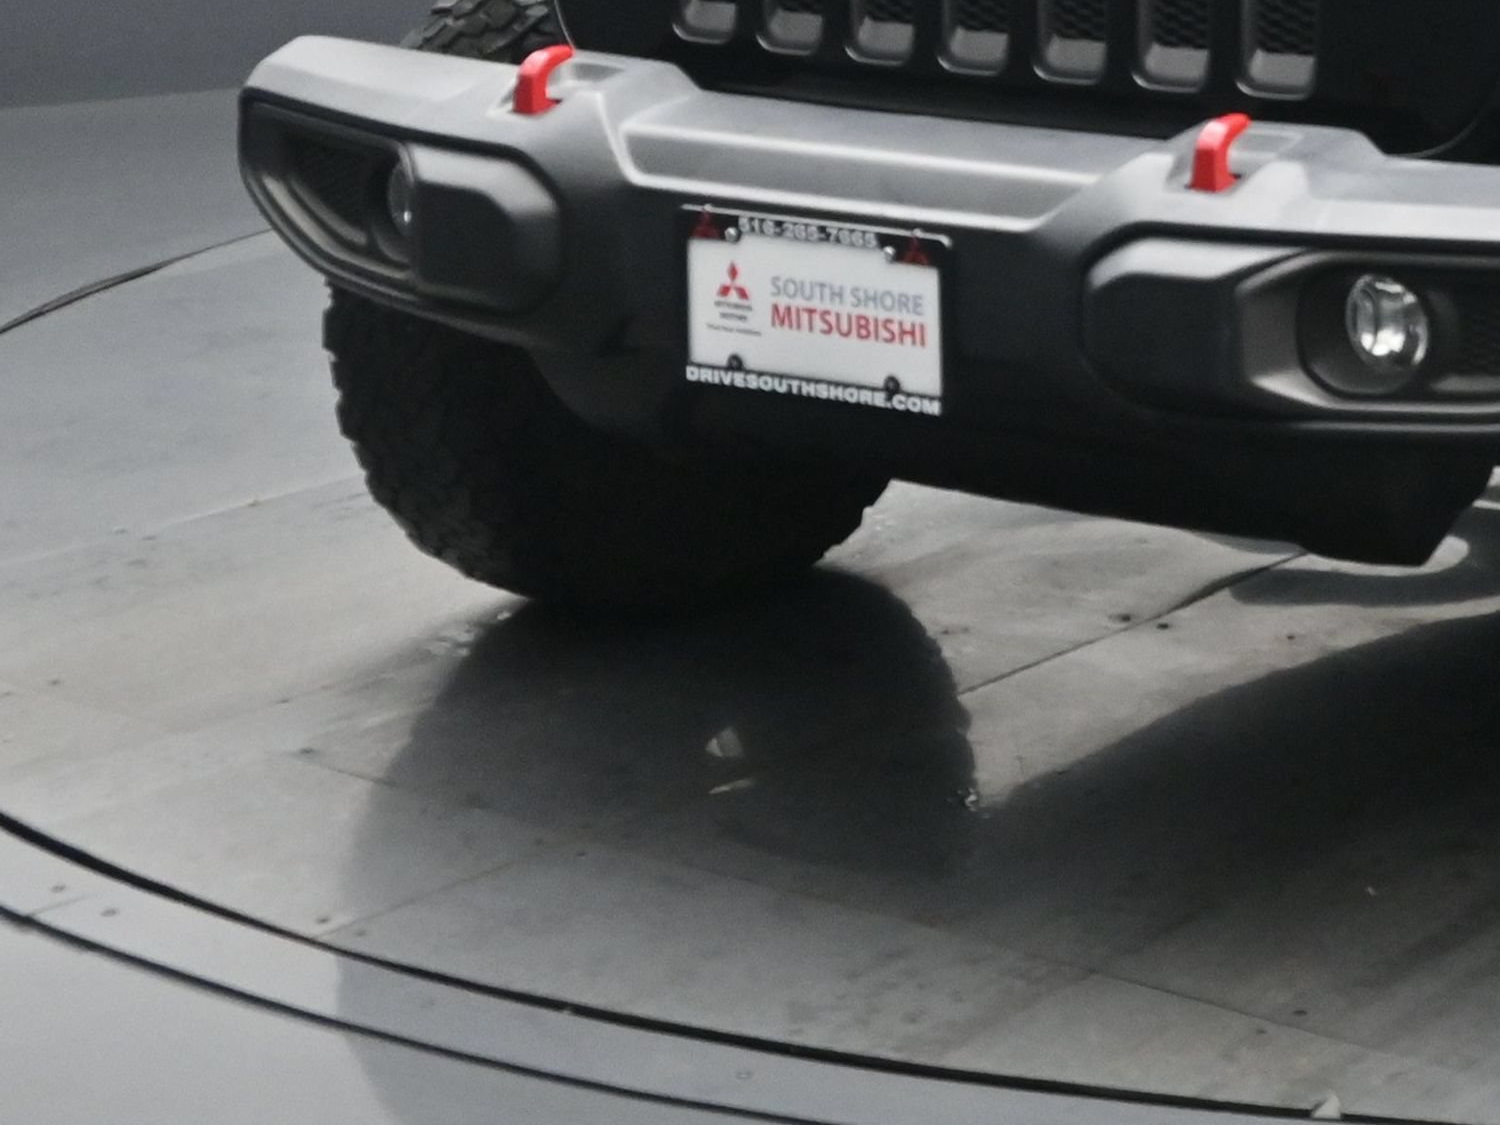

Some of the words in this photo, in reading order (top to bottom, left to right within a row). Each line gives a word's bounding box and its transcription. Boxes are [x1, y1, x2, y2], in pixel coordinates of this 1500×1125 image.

[770, 276, 844, 304] SOUTH
[851, 286, 924, 316] SHORE
[770, 303, 927, 347] MITSUBISHI
[686, 365, 942, 416] DRIVESOUTHSHORE.COM
